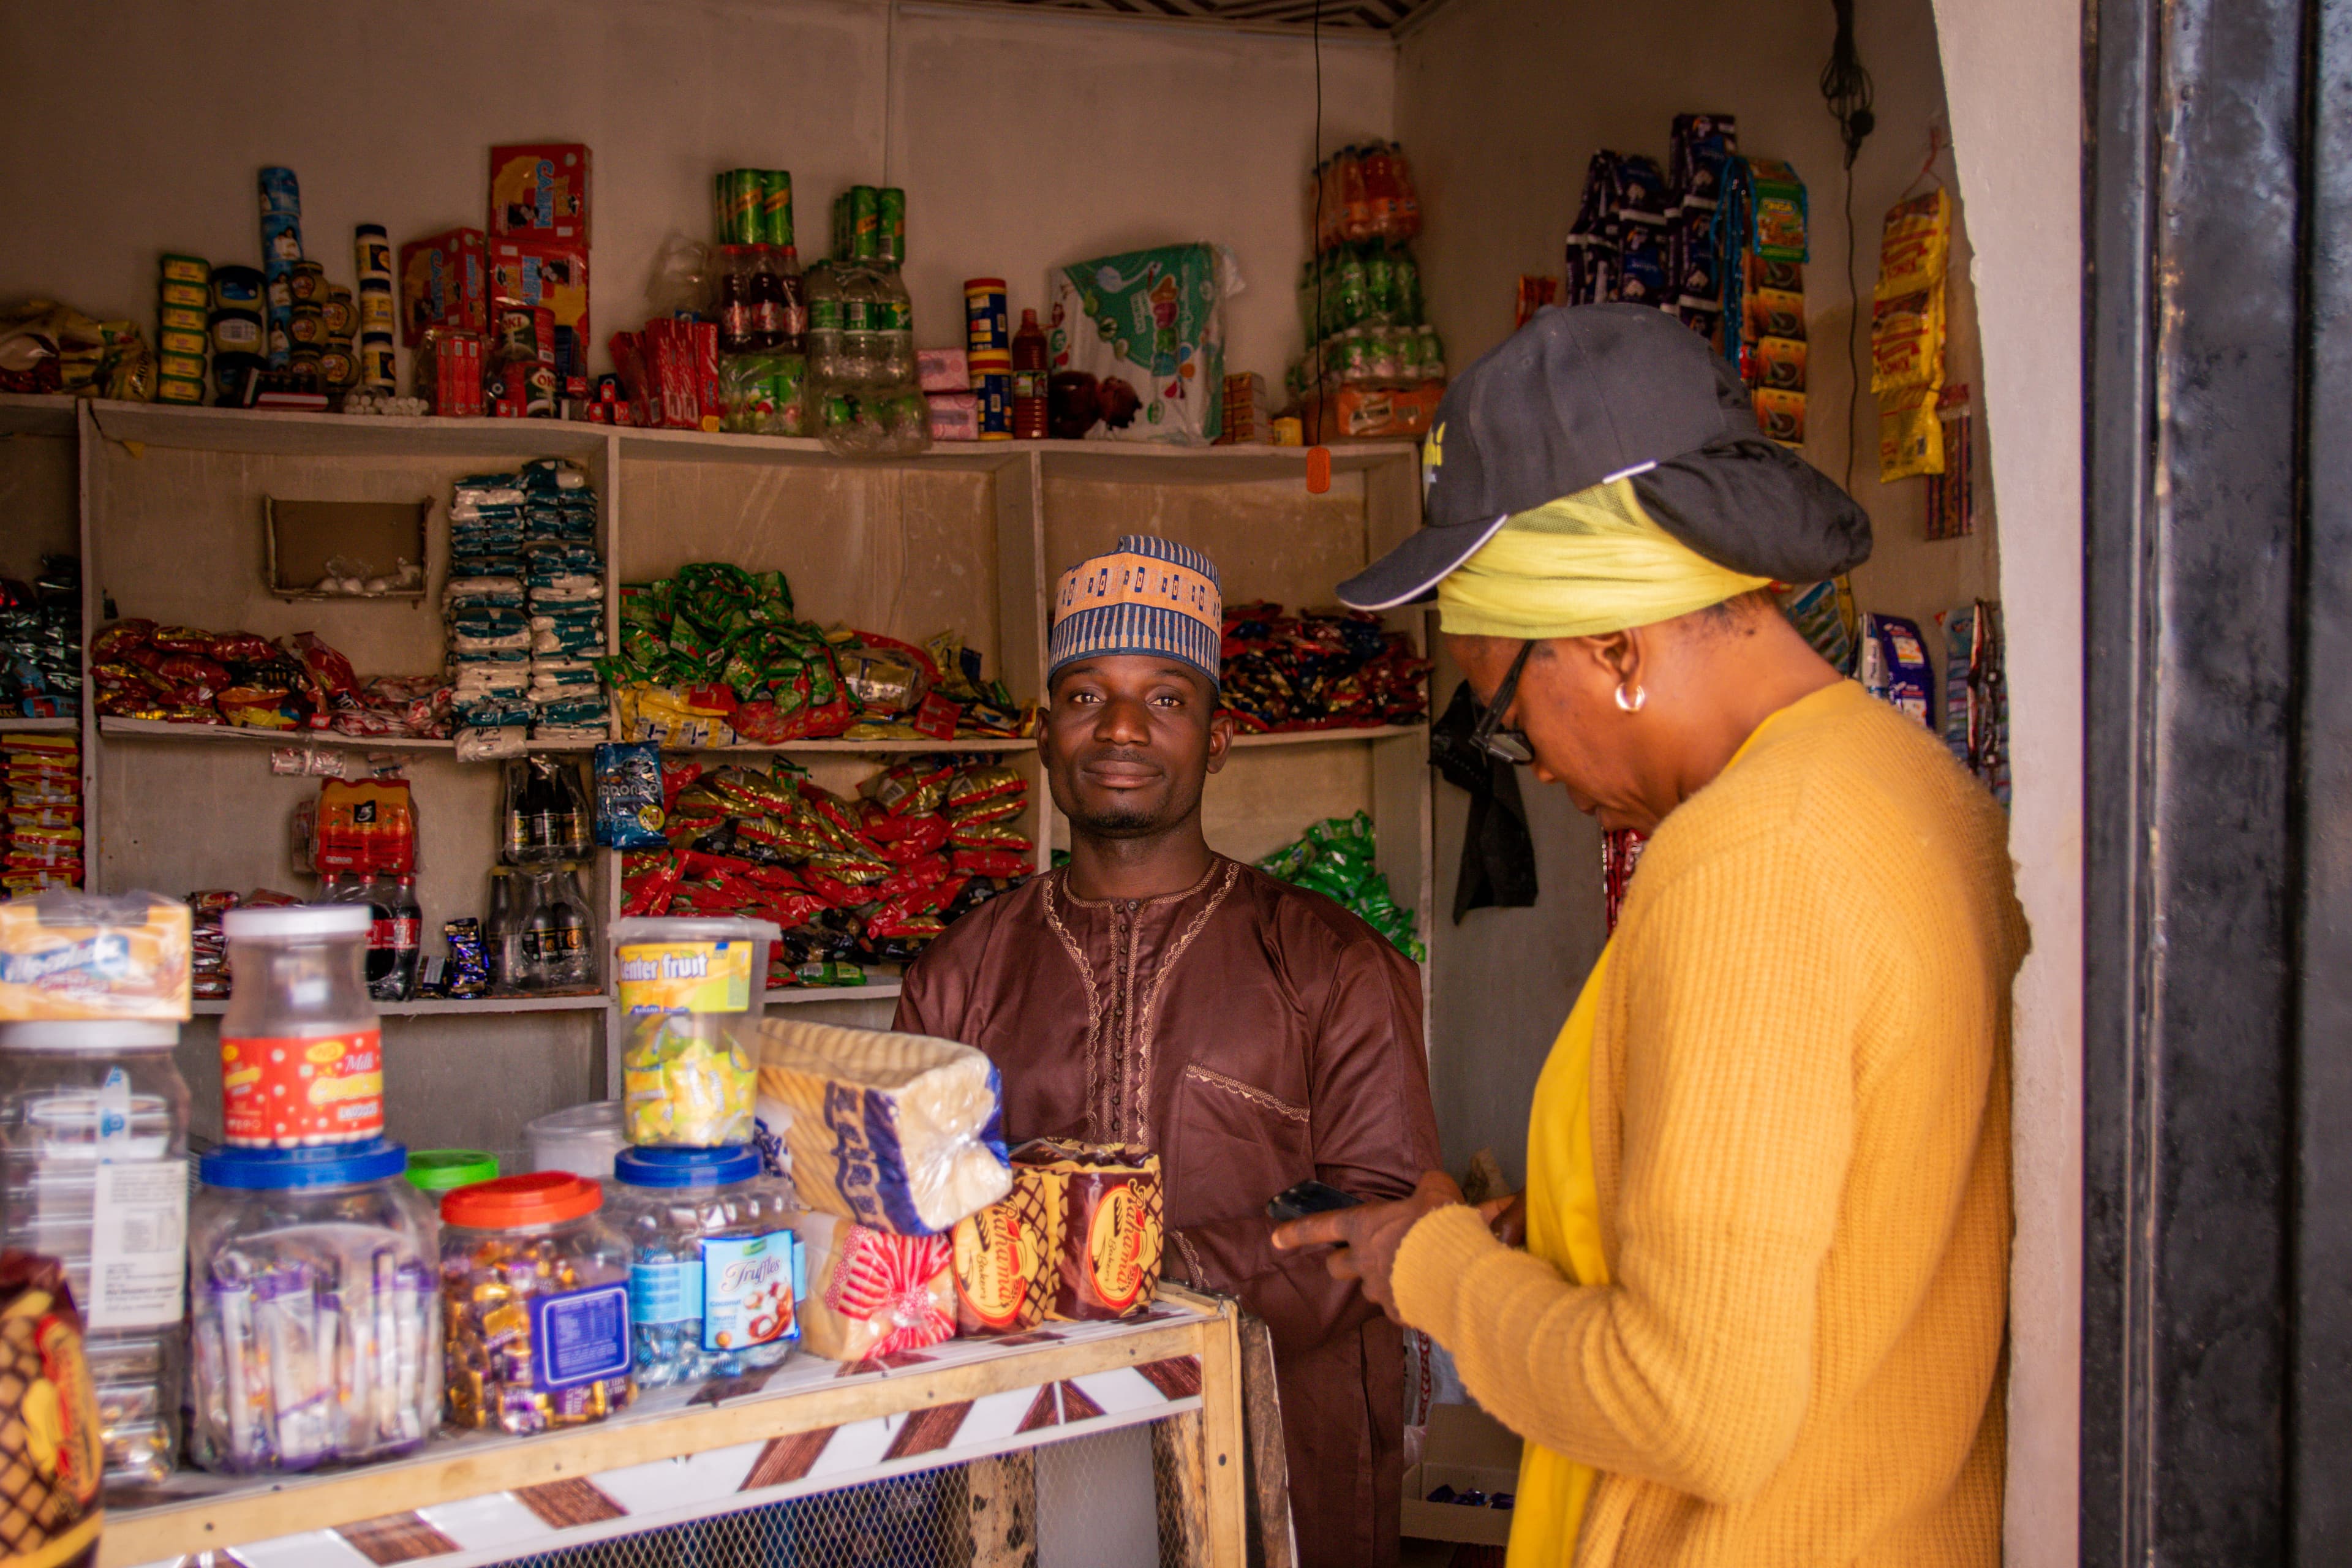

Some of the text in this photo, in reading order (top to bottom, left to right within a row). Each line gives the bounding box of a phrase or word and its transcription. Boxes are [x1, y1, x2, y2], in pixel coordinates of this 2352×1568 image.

[538, 373, 556, 388] OK
[662, 951, 709, 979] fruit
[993, 1193, 1020, 1310] Rahama
[1121, 1177, 1147, 1296] Rahama
[722, 1255, 781, 1292] Truffles
